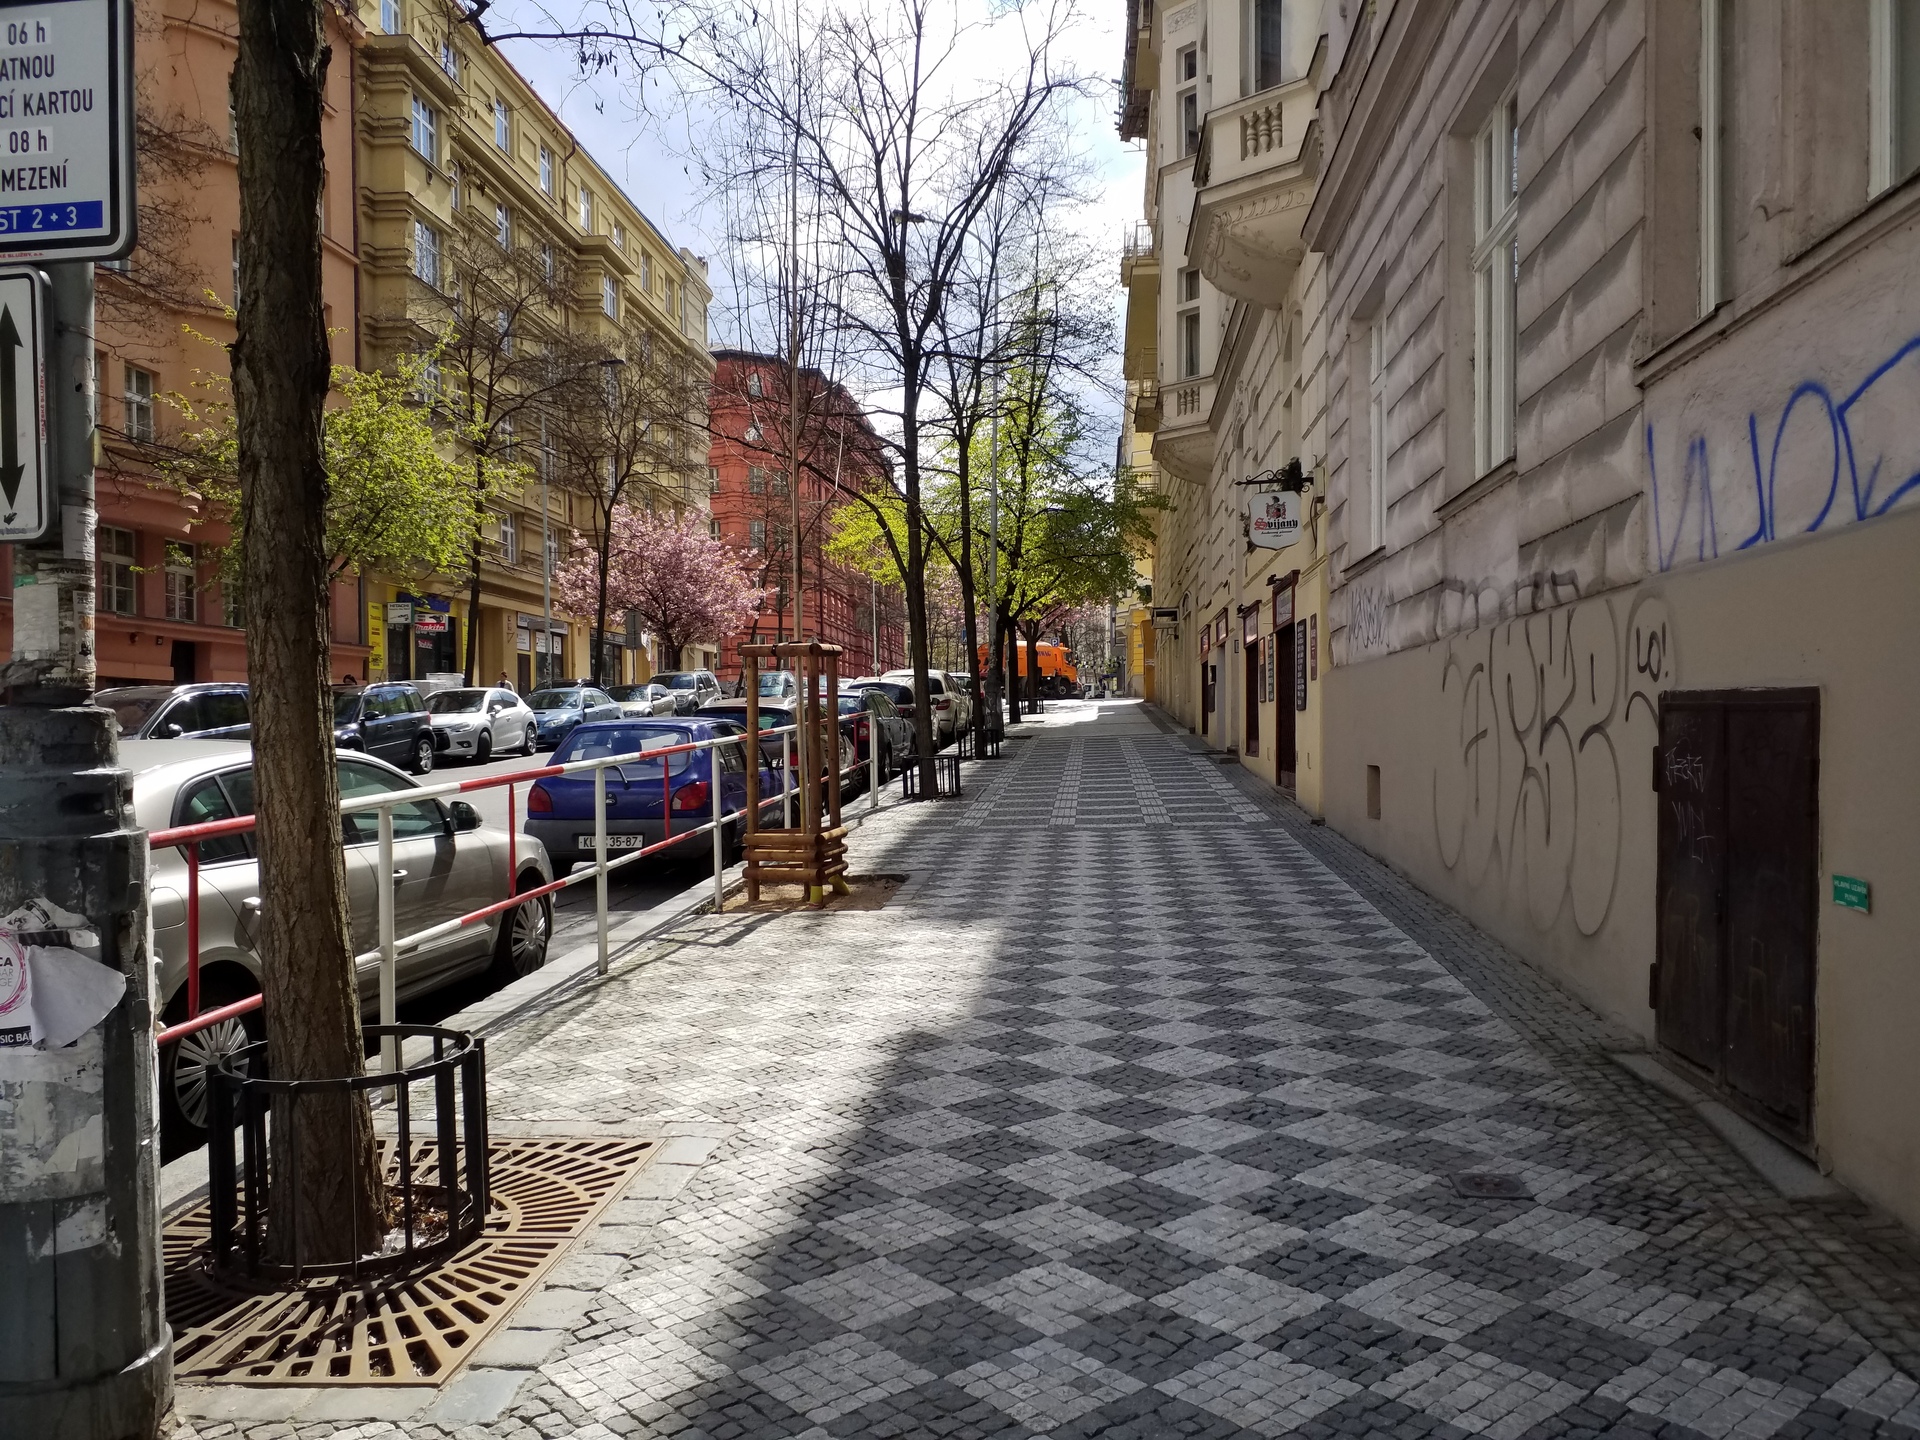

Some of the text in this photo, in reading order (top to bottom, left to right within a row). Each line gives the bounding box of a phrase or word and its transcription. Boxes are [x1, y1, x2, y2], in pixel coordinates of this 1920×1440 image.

[8, 20, 46, 45] 06 h
[0, 54, 55, 81] ATNOU
[0, 88, 93, 118] CÍ KARTOU
[9, 129, 47, 154] 08 h
[1, 158, 69, 192] MEZENÍ
[0, 206, 77, 231] ST 2 + 3
[1254, 517, 1299, 531] Svijany
[609, 836, 639, 848] 35-87
